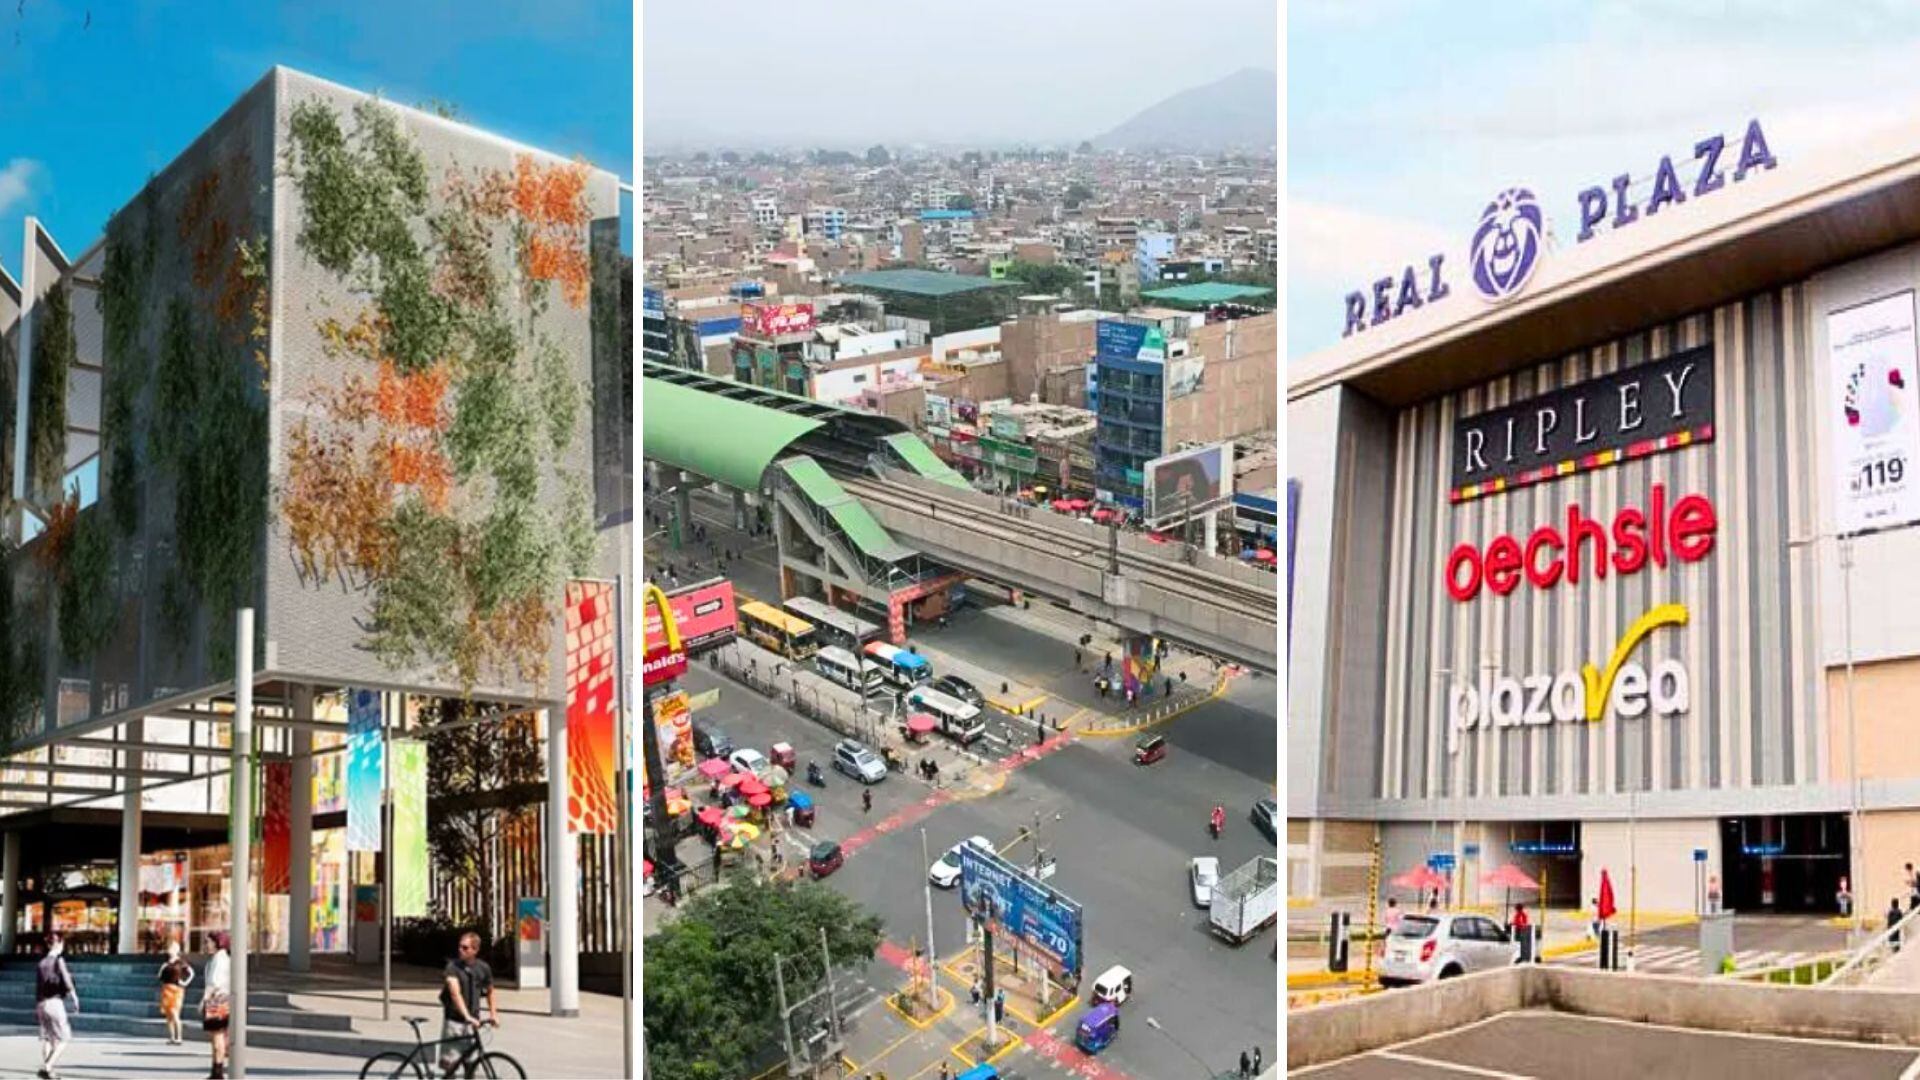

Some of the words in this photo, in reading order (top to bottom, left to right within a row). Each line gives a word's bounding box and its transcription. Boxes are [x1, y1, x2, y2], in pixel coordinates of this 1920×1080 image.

[1342, 254, 1449, 338] REAL
[1577, 118, 1777, 243] PLAZA
[1464, 362, 1694, 473] RIPLEY
[1446, 483, 1717, 602] oechsle
[963, 855, 1013, 887] INTERNET
[1049, 931, 1067, 953] 70
